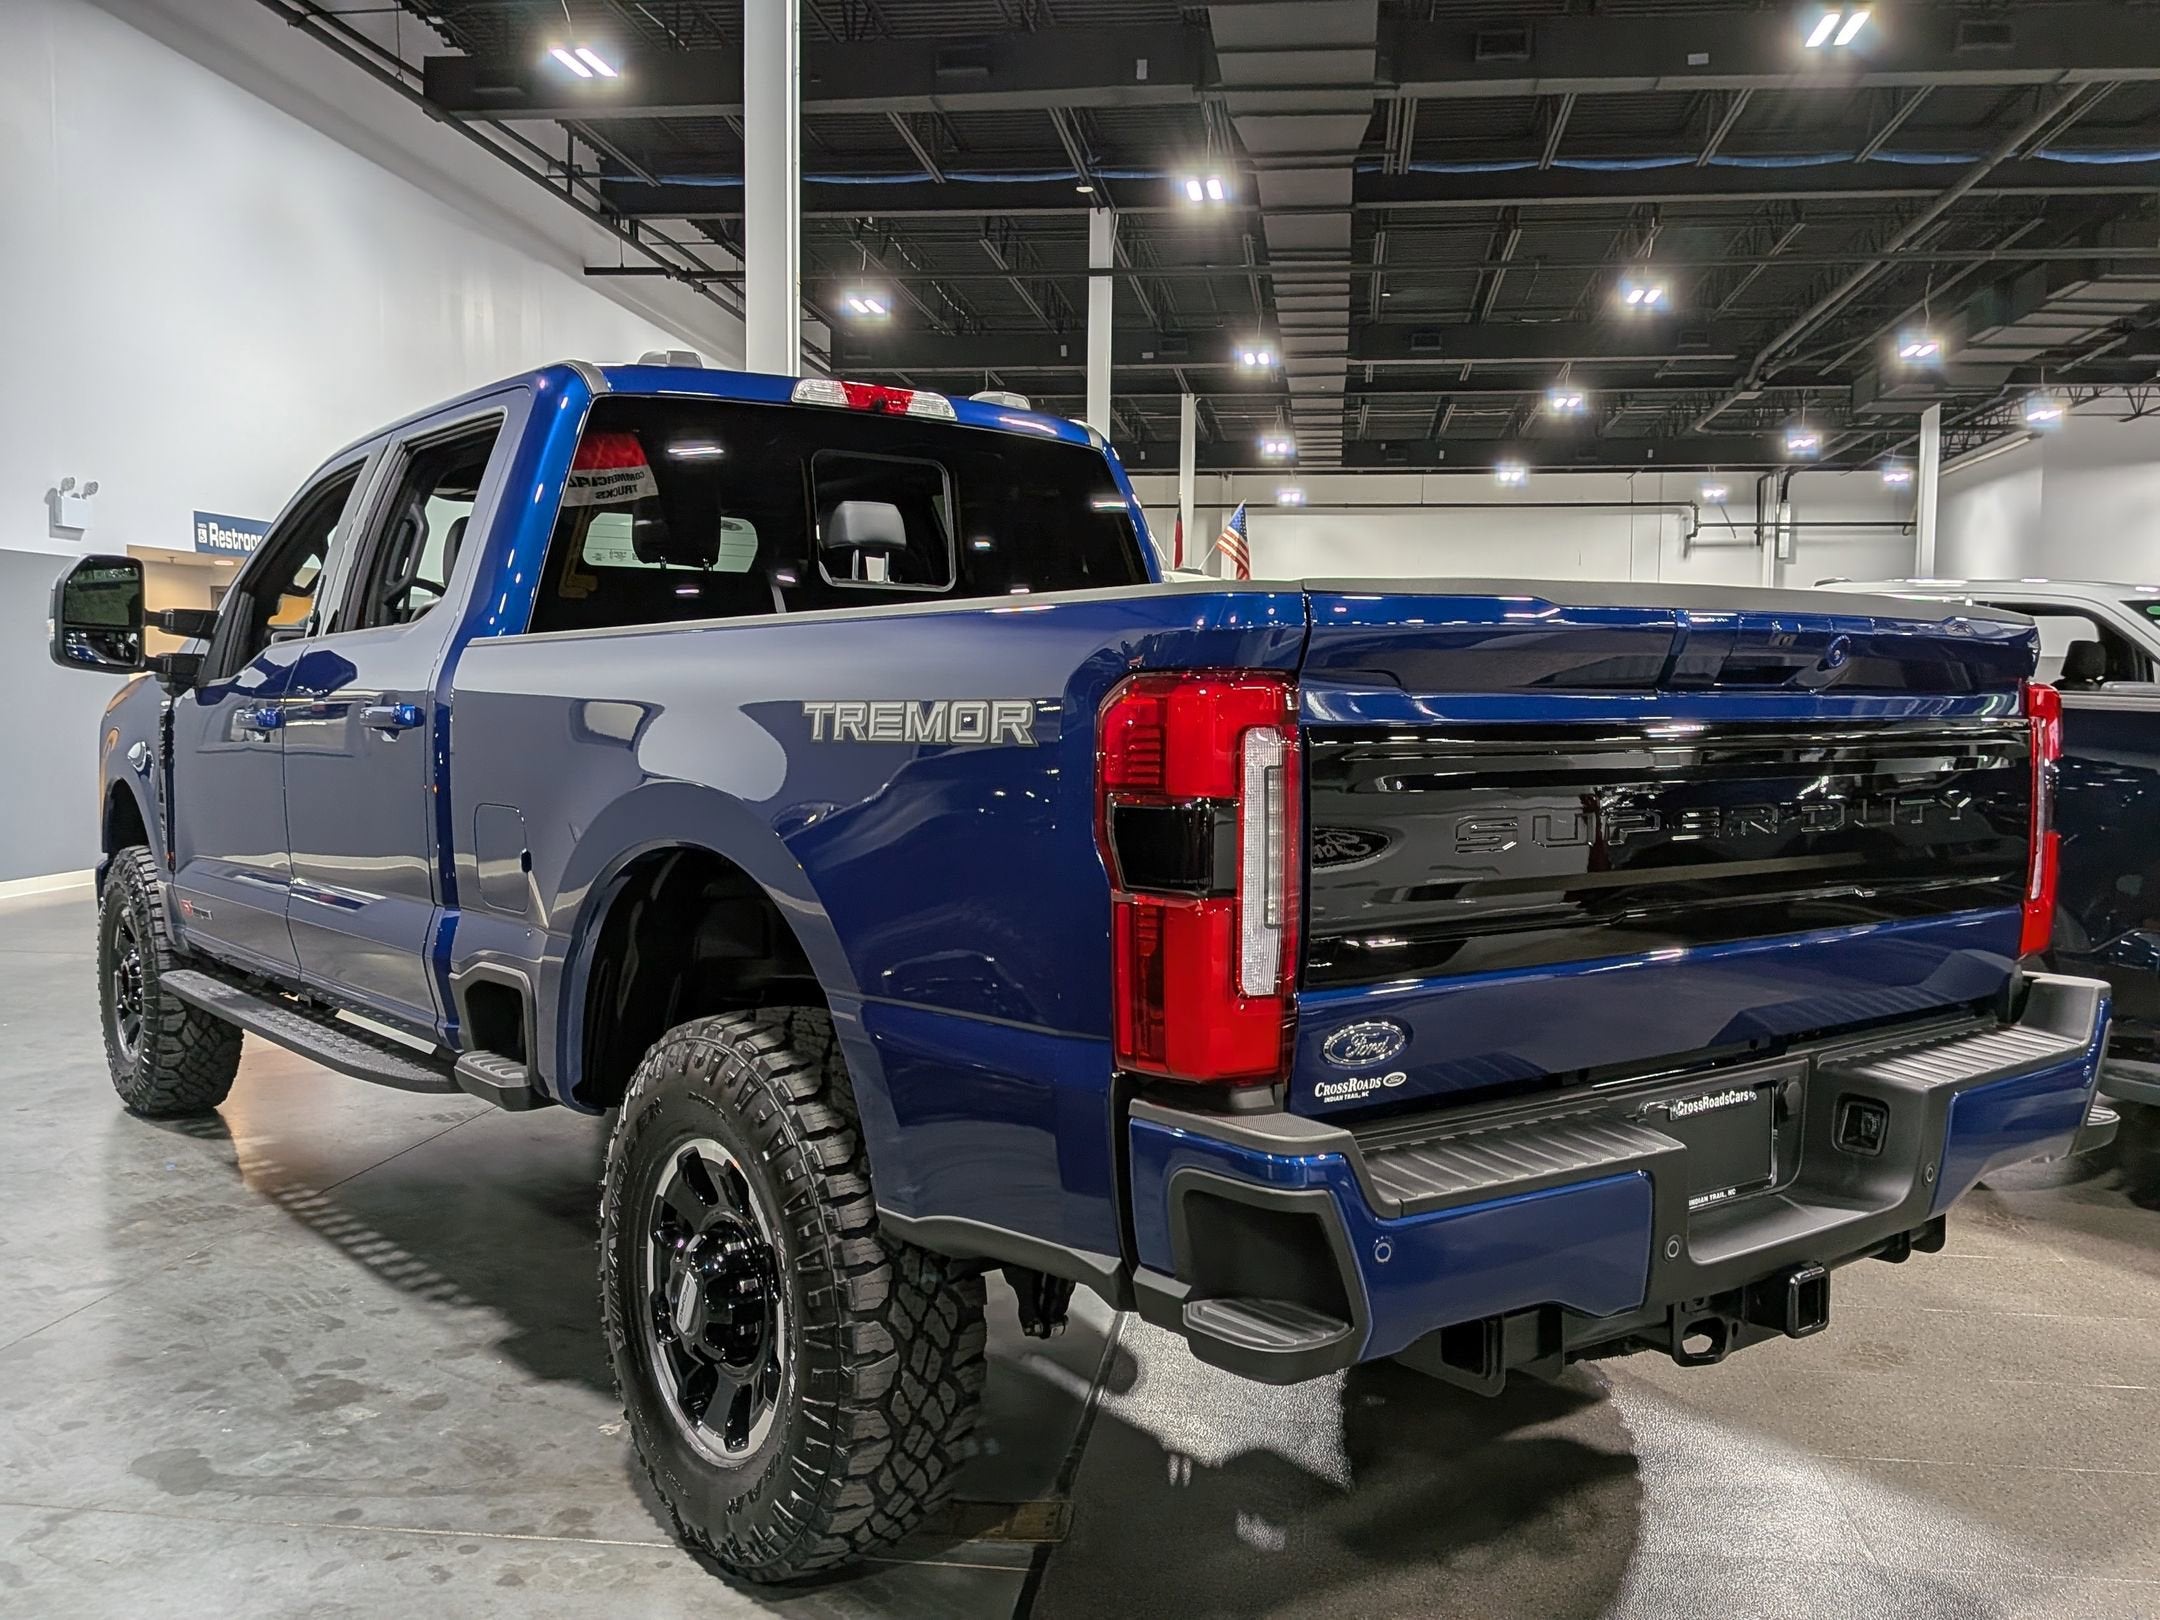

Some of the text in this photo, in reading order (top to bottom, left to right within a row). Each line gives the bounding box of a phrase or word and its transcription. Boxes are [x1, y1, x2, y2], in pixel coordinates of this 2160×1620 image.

[208, 522, 263, 551] Restroo
[803, 700, 1037, 746] TREMOR
[1323, 1095, 1344, 1104] INDIAN
[1361, 1090, 1370, 1098] NC
[1727, 1188, 1736, 1196] NC
